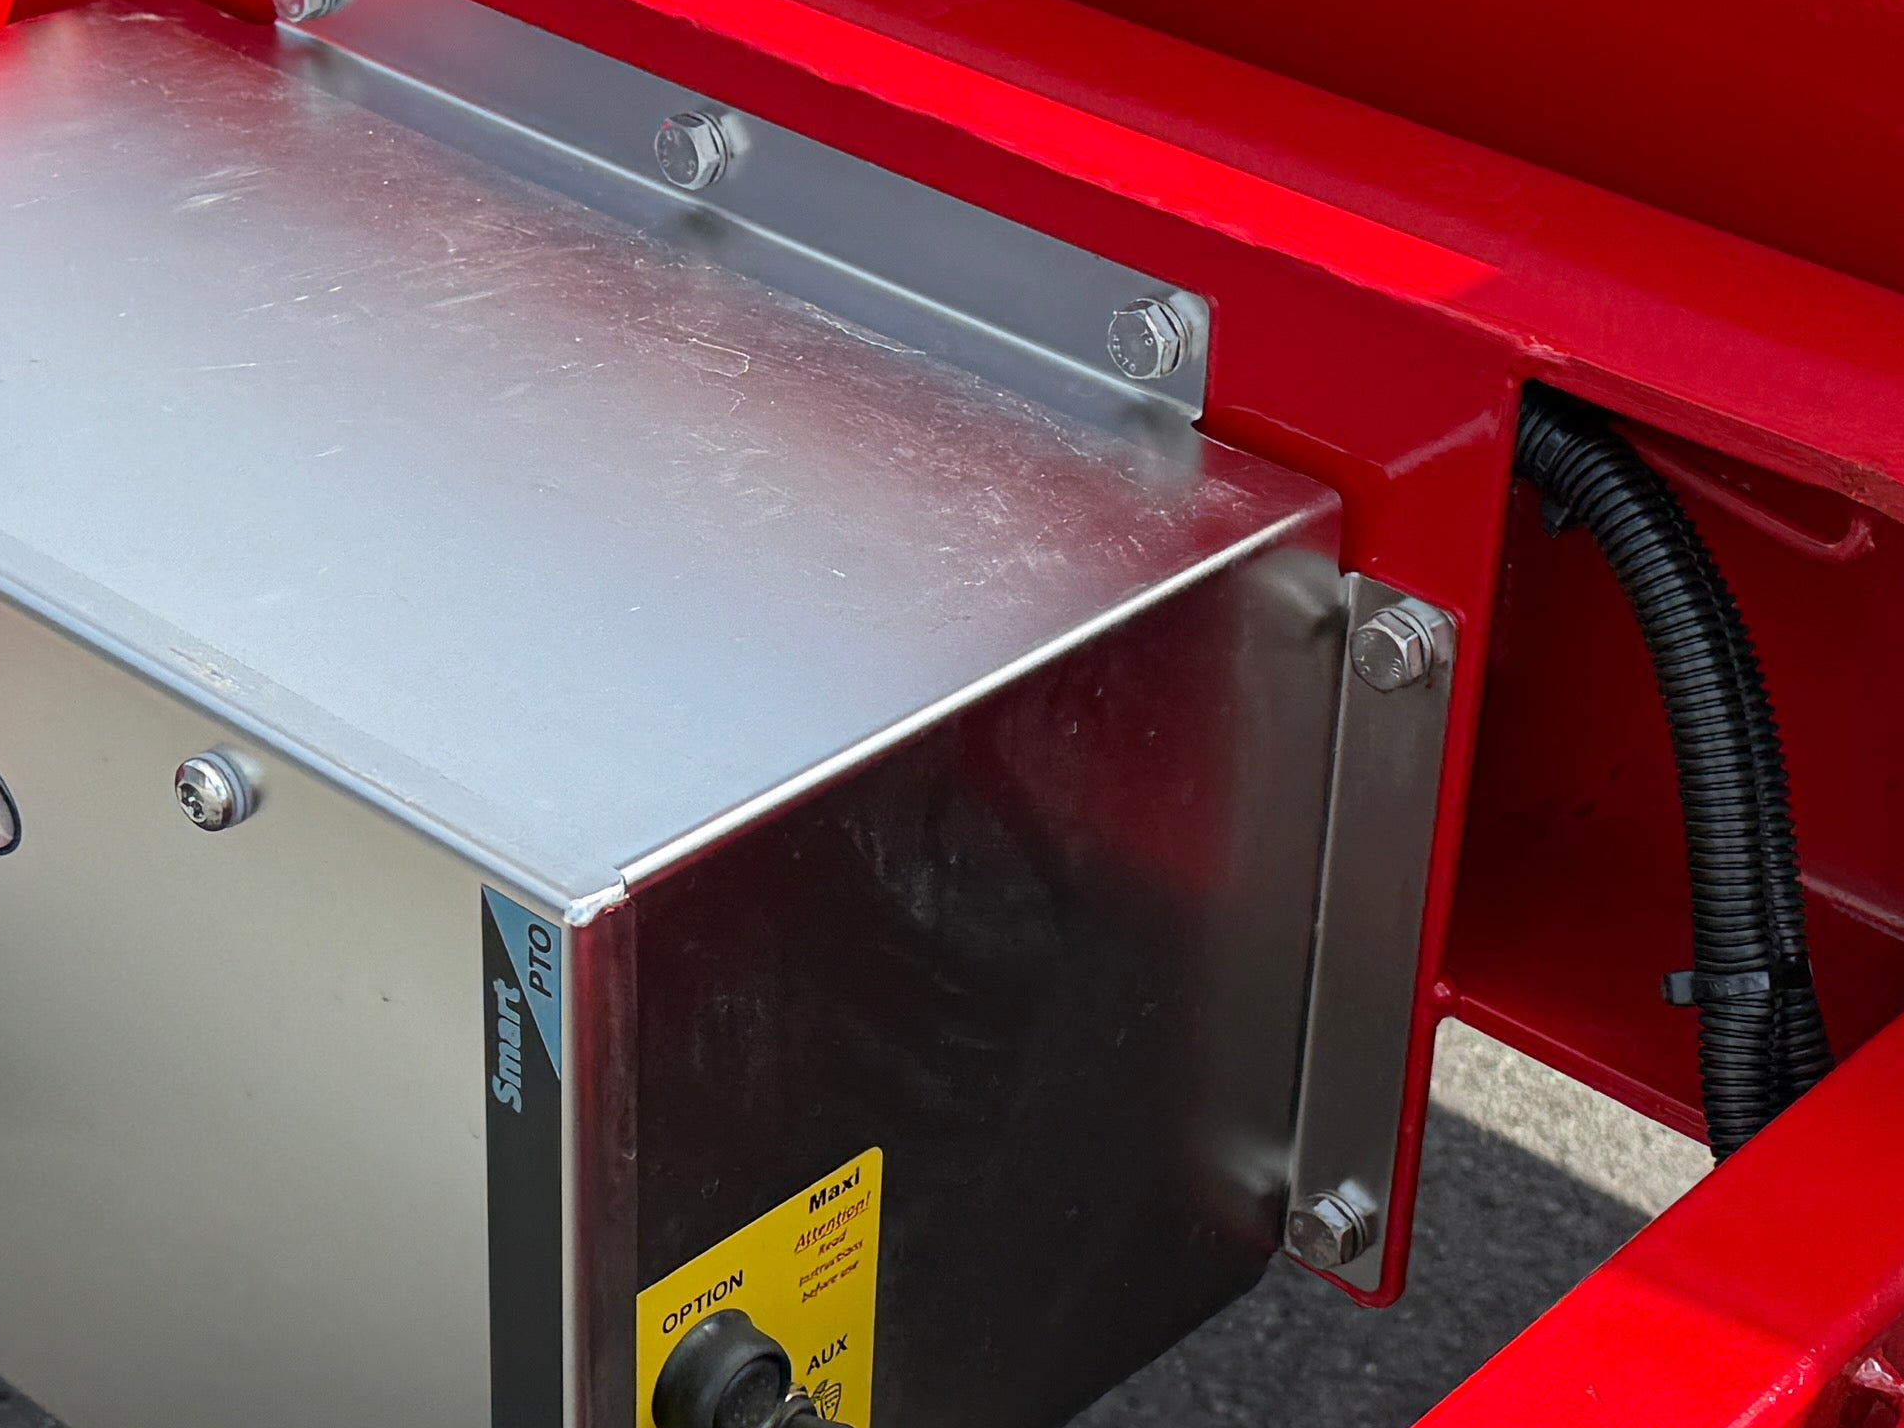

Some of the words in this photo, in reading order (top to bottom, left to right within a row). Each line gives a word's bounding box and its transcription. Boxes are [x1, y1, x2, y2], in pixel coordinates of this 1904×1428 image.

[528, 923, 553, 999] PTO
[492, 978, 523, 1114] Smart
[809, 1166, 861, 1215] Maxi
[662, 1269, 744, 1335] OPTION
[807, 1333, 849, 1376] AUX
